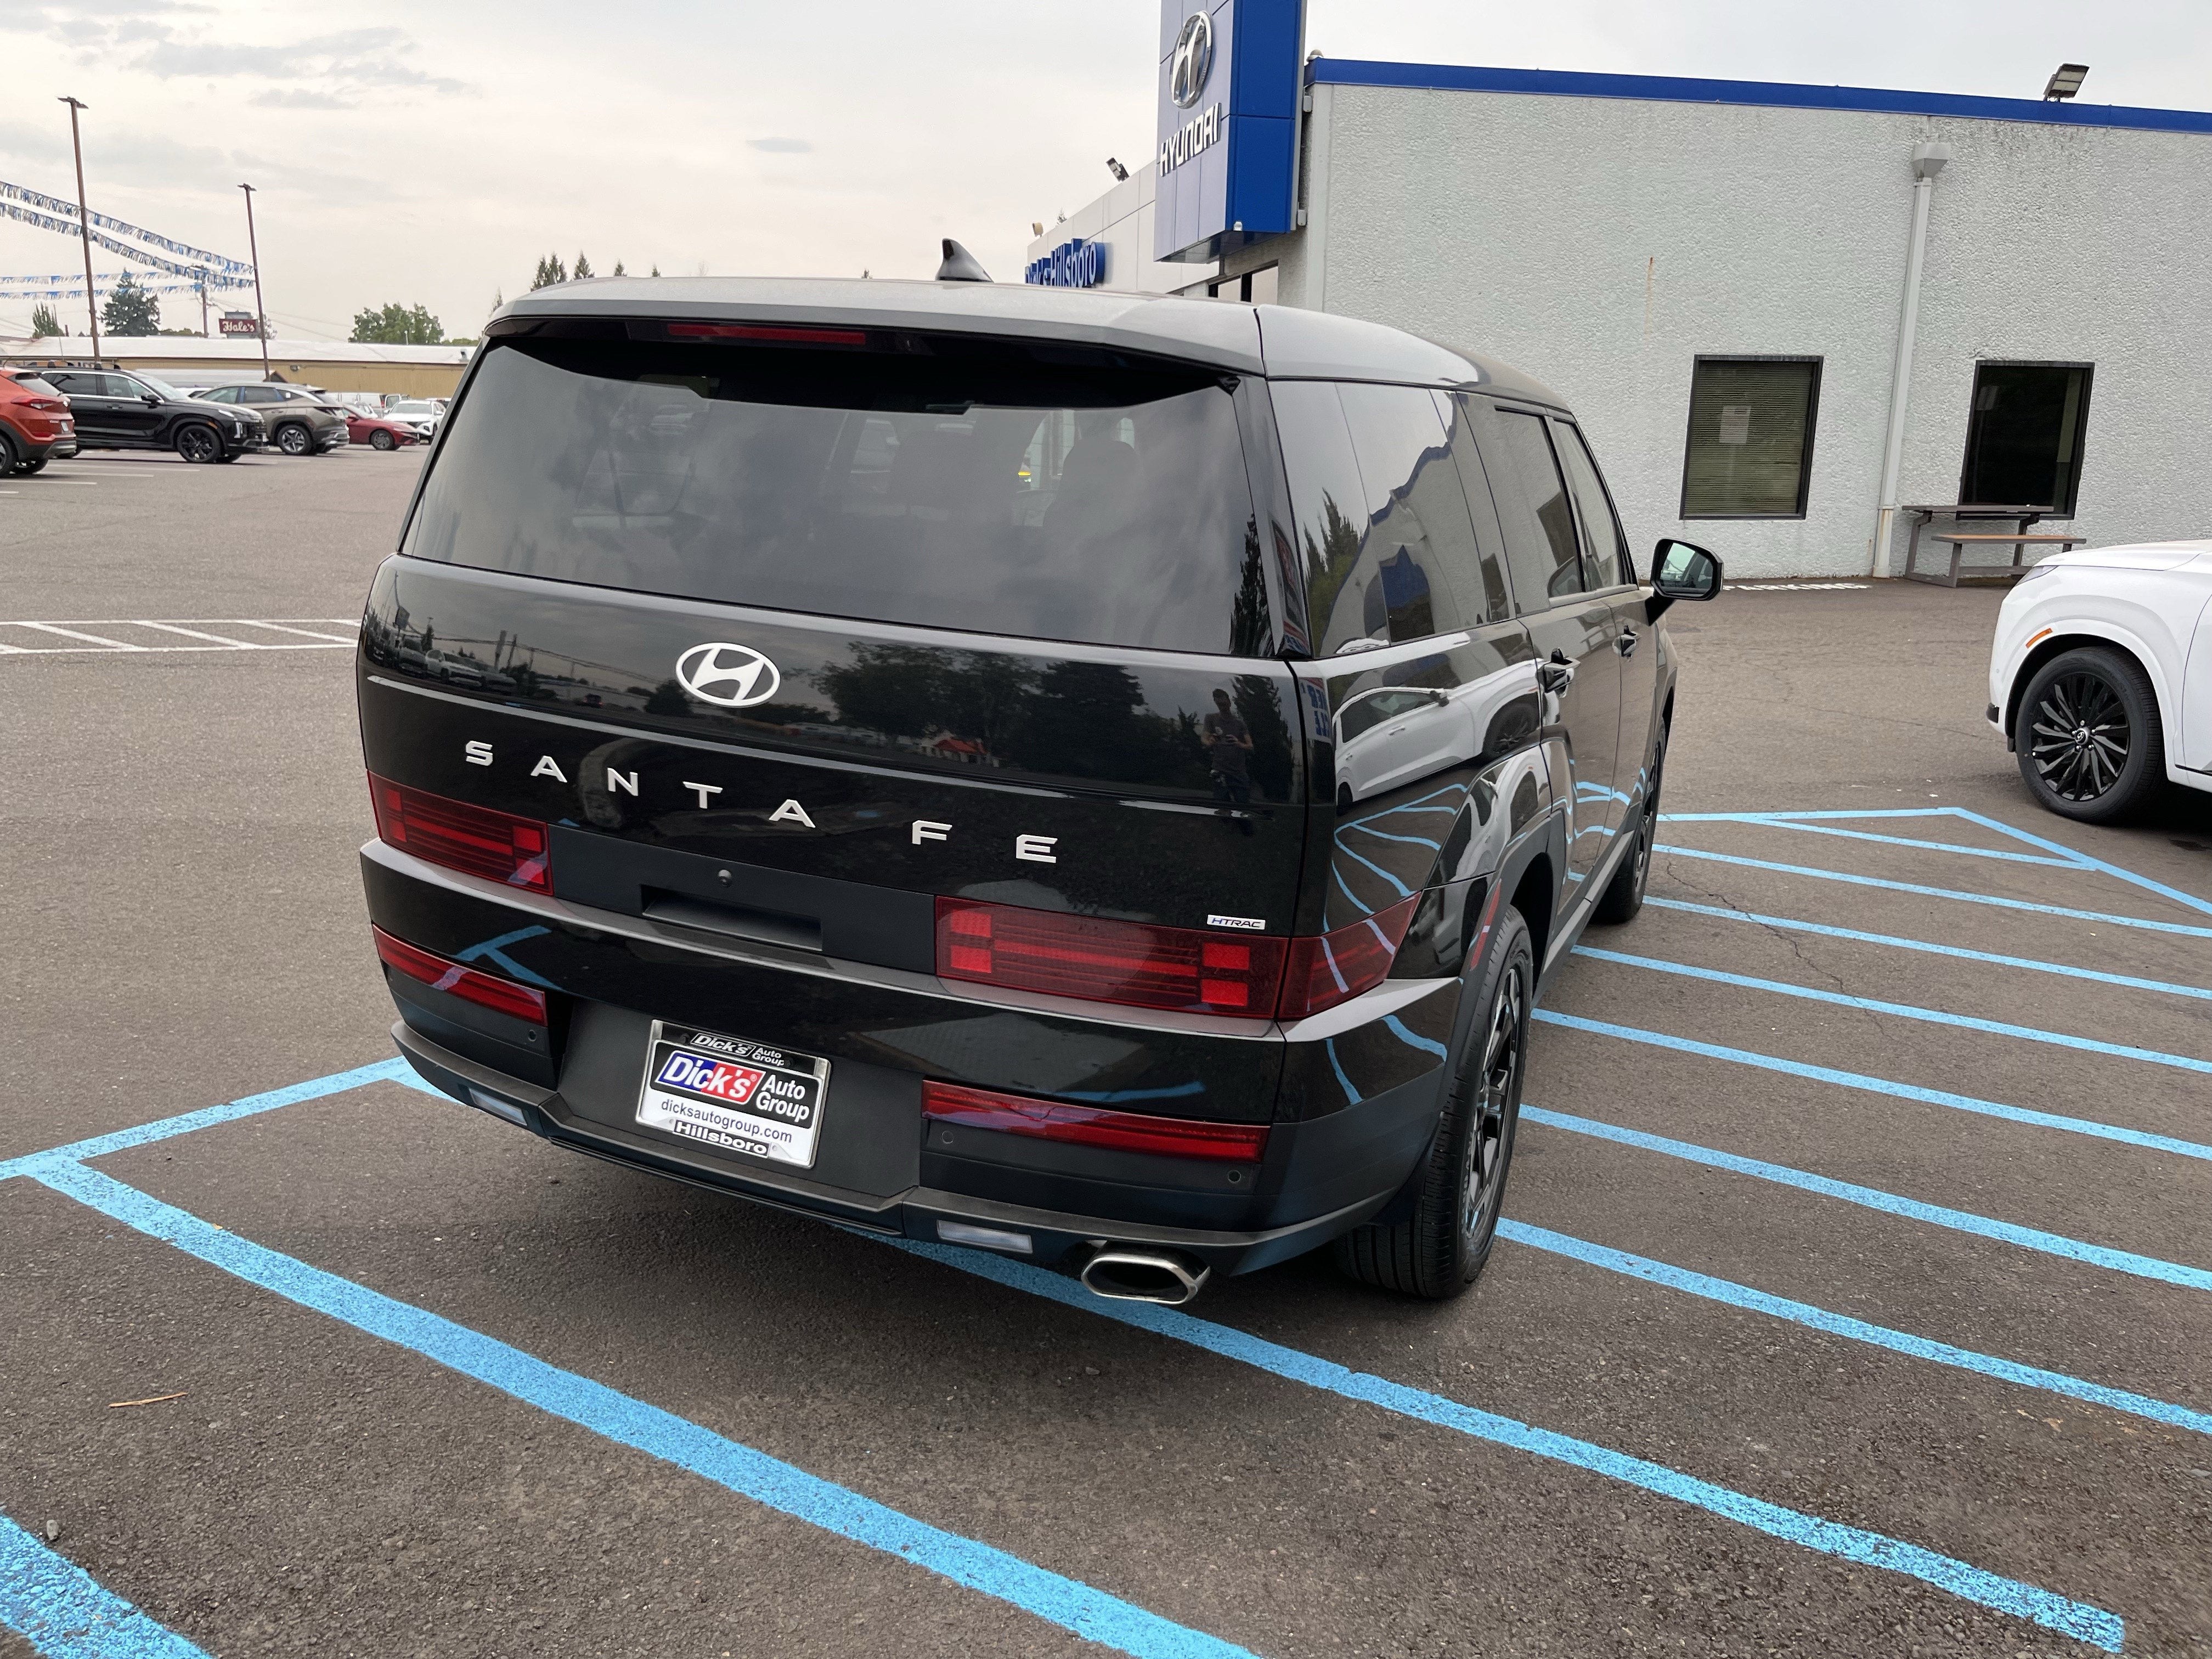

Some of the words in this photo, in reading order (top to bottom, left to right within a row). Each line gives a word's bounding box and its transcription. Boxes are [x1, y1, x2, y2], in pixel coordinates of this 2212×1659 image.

[1160, 102, 1220, 177] HYUNDAI
[1050, 238, 1099, 288] Hillsboro
[222, 320, 255, 332] Hale's
[465, 741, 816, 828] SANTA
[912, 820, 1058, 864] FE
[1211, 918, 1261, 928] HTRAC
[694, 1035, 749, 1055] Dick's
[752, 1053, 785, 1066] Group
[755, 1047, 782, 1059] Auto
[663, 1056, 752, 1098] Dick's
[761, 1074, 806, 1100] Auto
[661, 1098, 793, 1143] dicksautogroup.com
[755, 1091, 810, 1123] Group
[676, 1121, 768, 1155] Hillsboro
